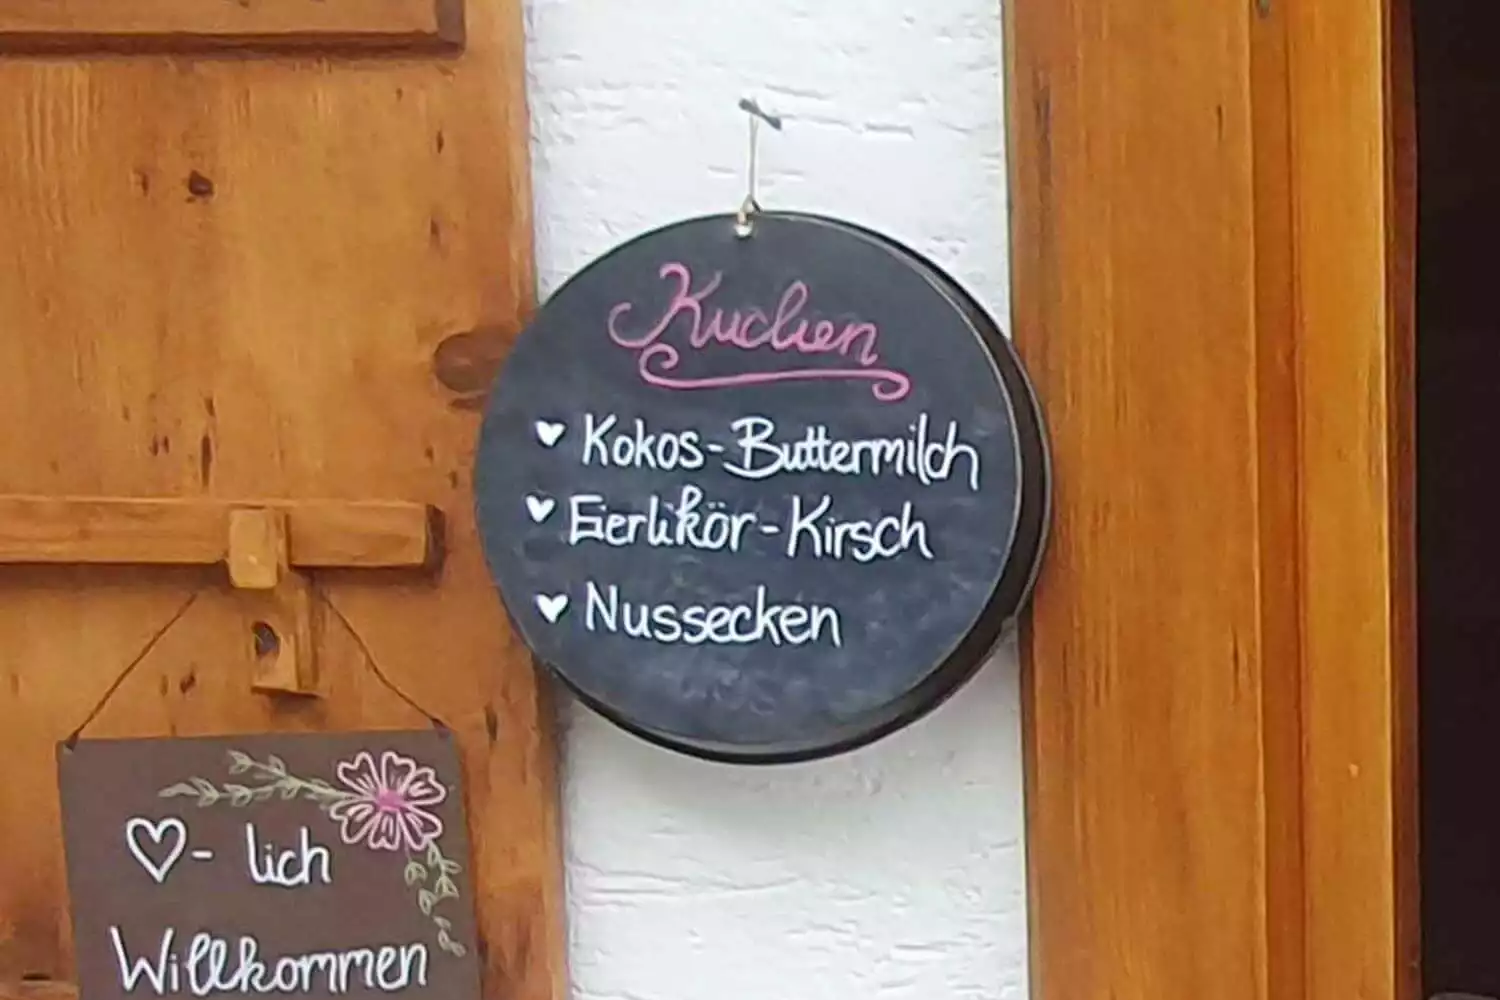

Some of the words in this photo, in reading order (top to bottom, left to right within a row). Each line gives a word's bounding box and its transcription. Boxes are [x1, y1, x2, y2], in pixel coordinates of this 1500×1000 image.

[608, 262, 878, 366] Kuchen
[581, 412, 980, 490] Kokos-Buttermilch
[568, 485, 934, 563] Eierlikör-Kirsch
[584, 581, 842, 647] Nussecken
[245, 822, 333, 886] lich
[109, 924, 430, 995] Willkommen
